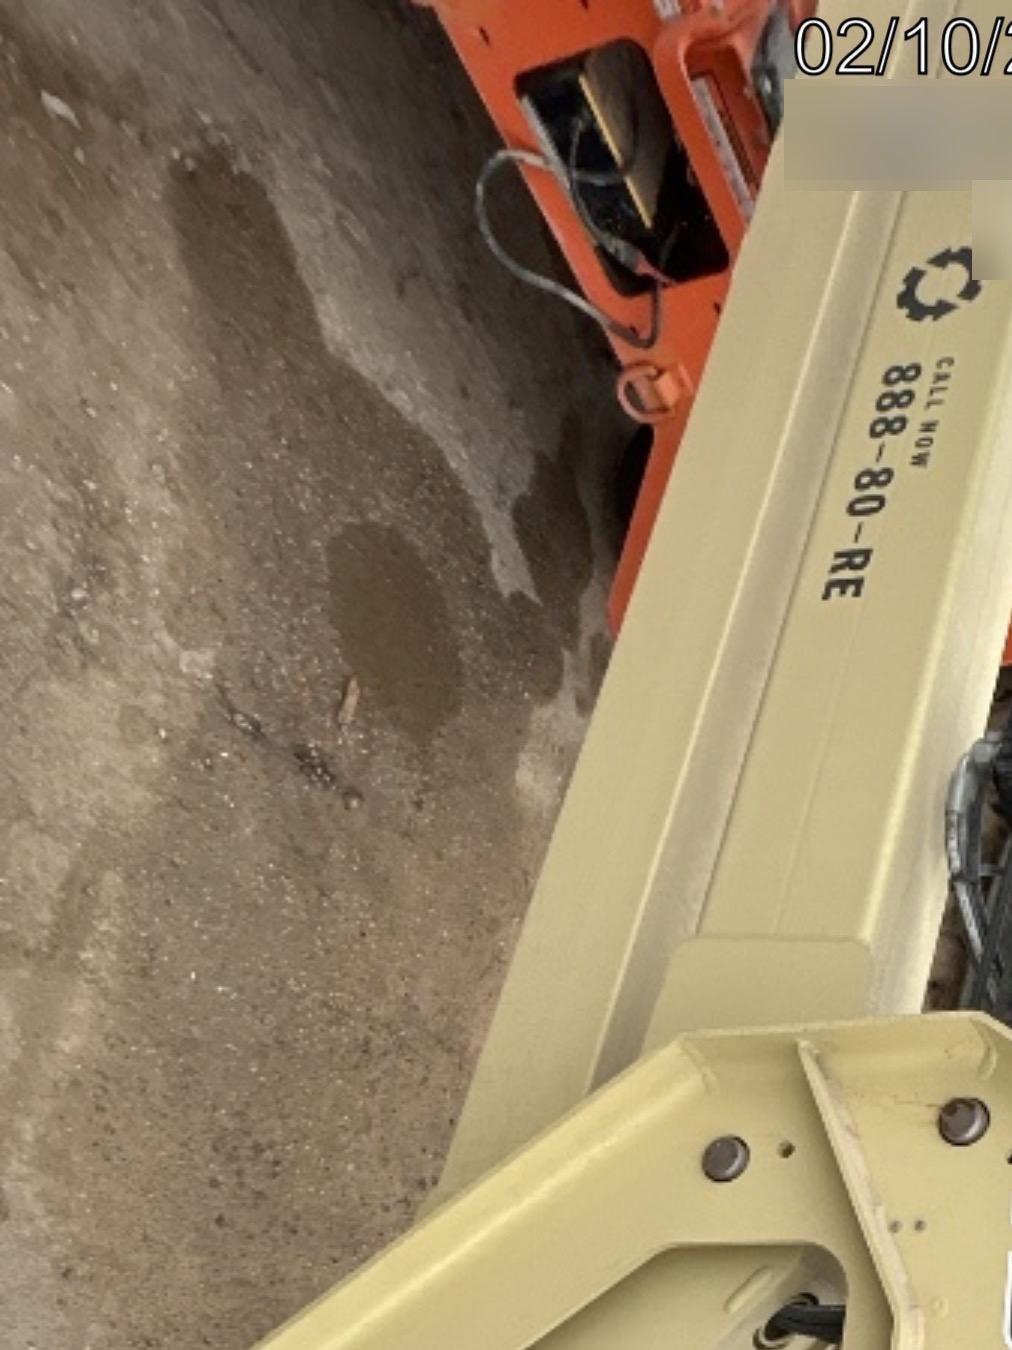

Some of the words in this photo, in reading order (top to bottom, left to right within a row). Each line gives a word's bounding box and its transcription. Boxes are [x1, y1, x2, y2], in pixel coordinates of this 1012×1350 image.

[925, 356, 955, 409] CALL
[910, 419, 938, 468] NOW
[822, 361, 923, 602] 888-80-RE
